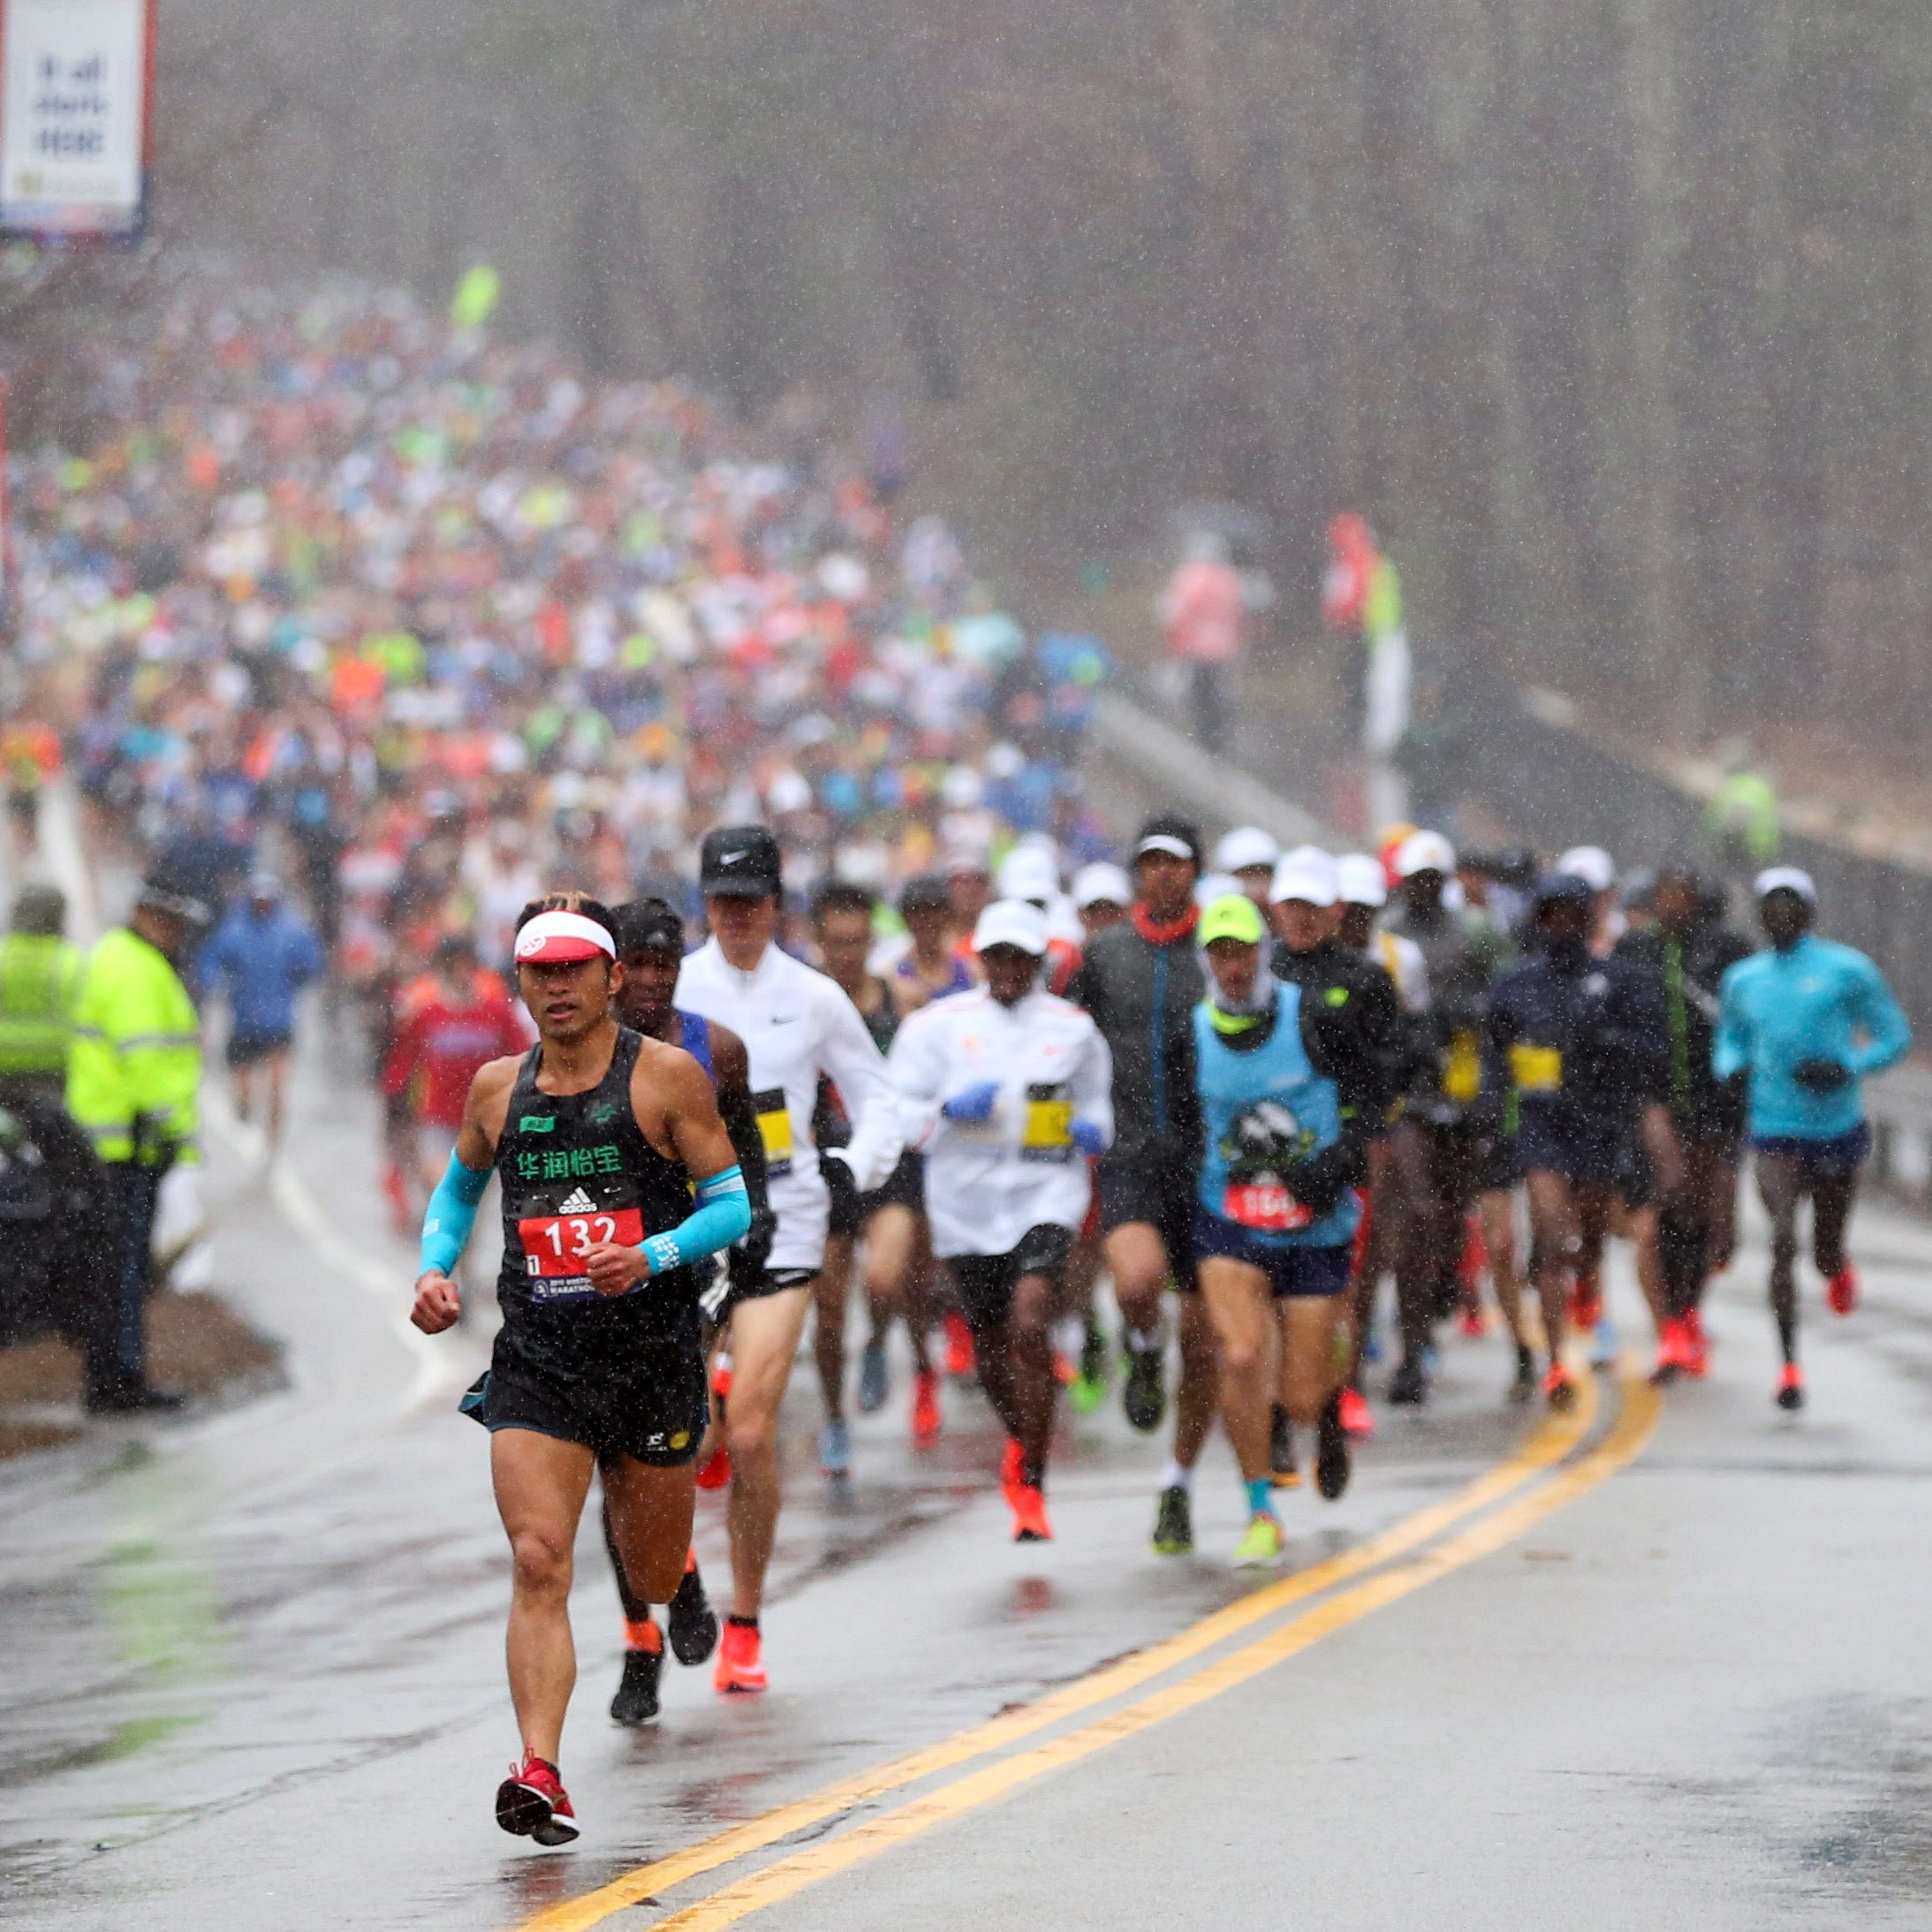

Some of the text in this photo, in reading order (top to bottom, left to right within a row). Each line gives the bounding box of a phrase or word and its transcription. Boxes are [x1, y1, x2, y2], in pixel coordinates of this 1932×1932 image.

[517, 1145, 623, 1179] 华润怡宝
[558, 1202, 598, 1215] adidas
[544, 1216, 617, 1256] 132
